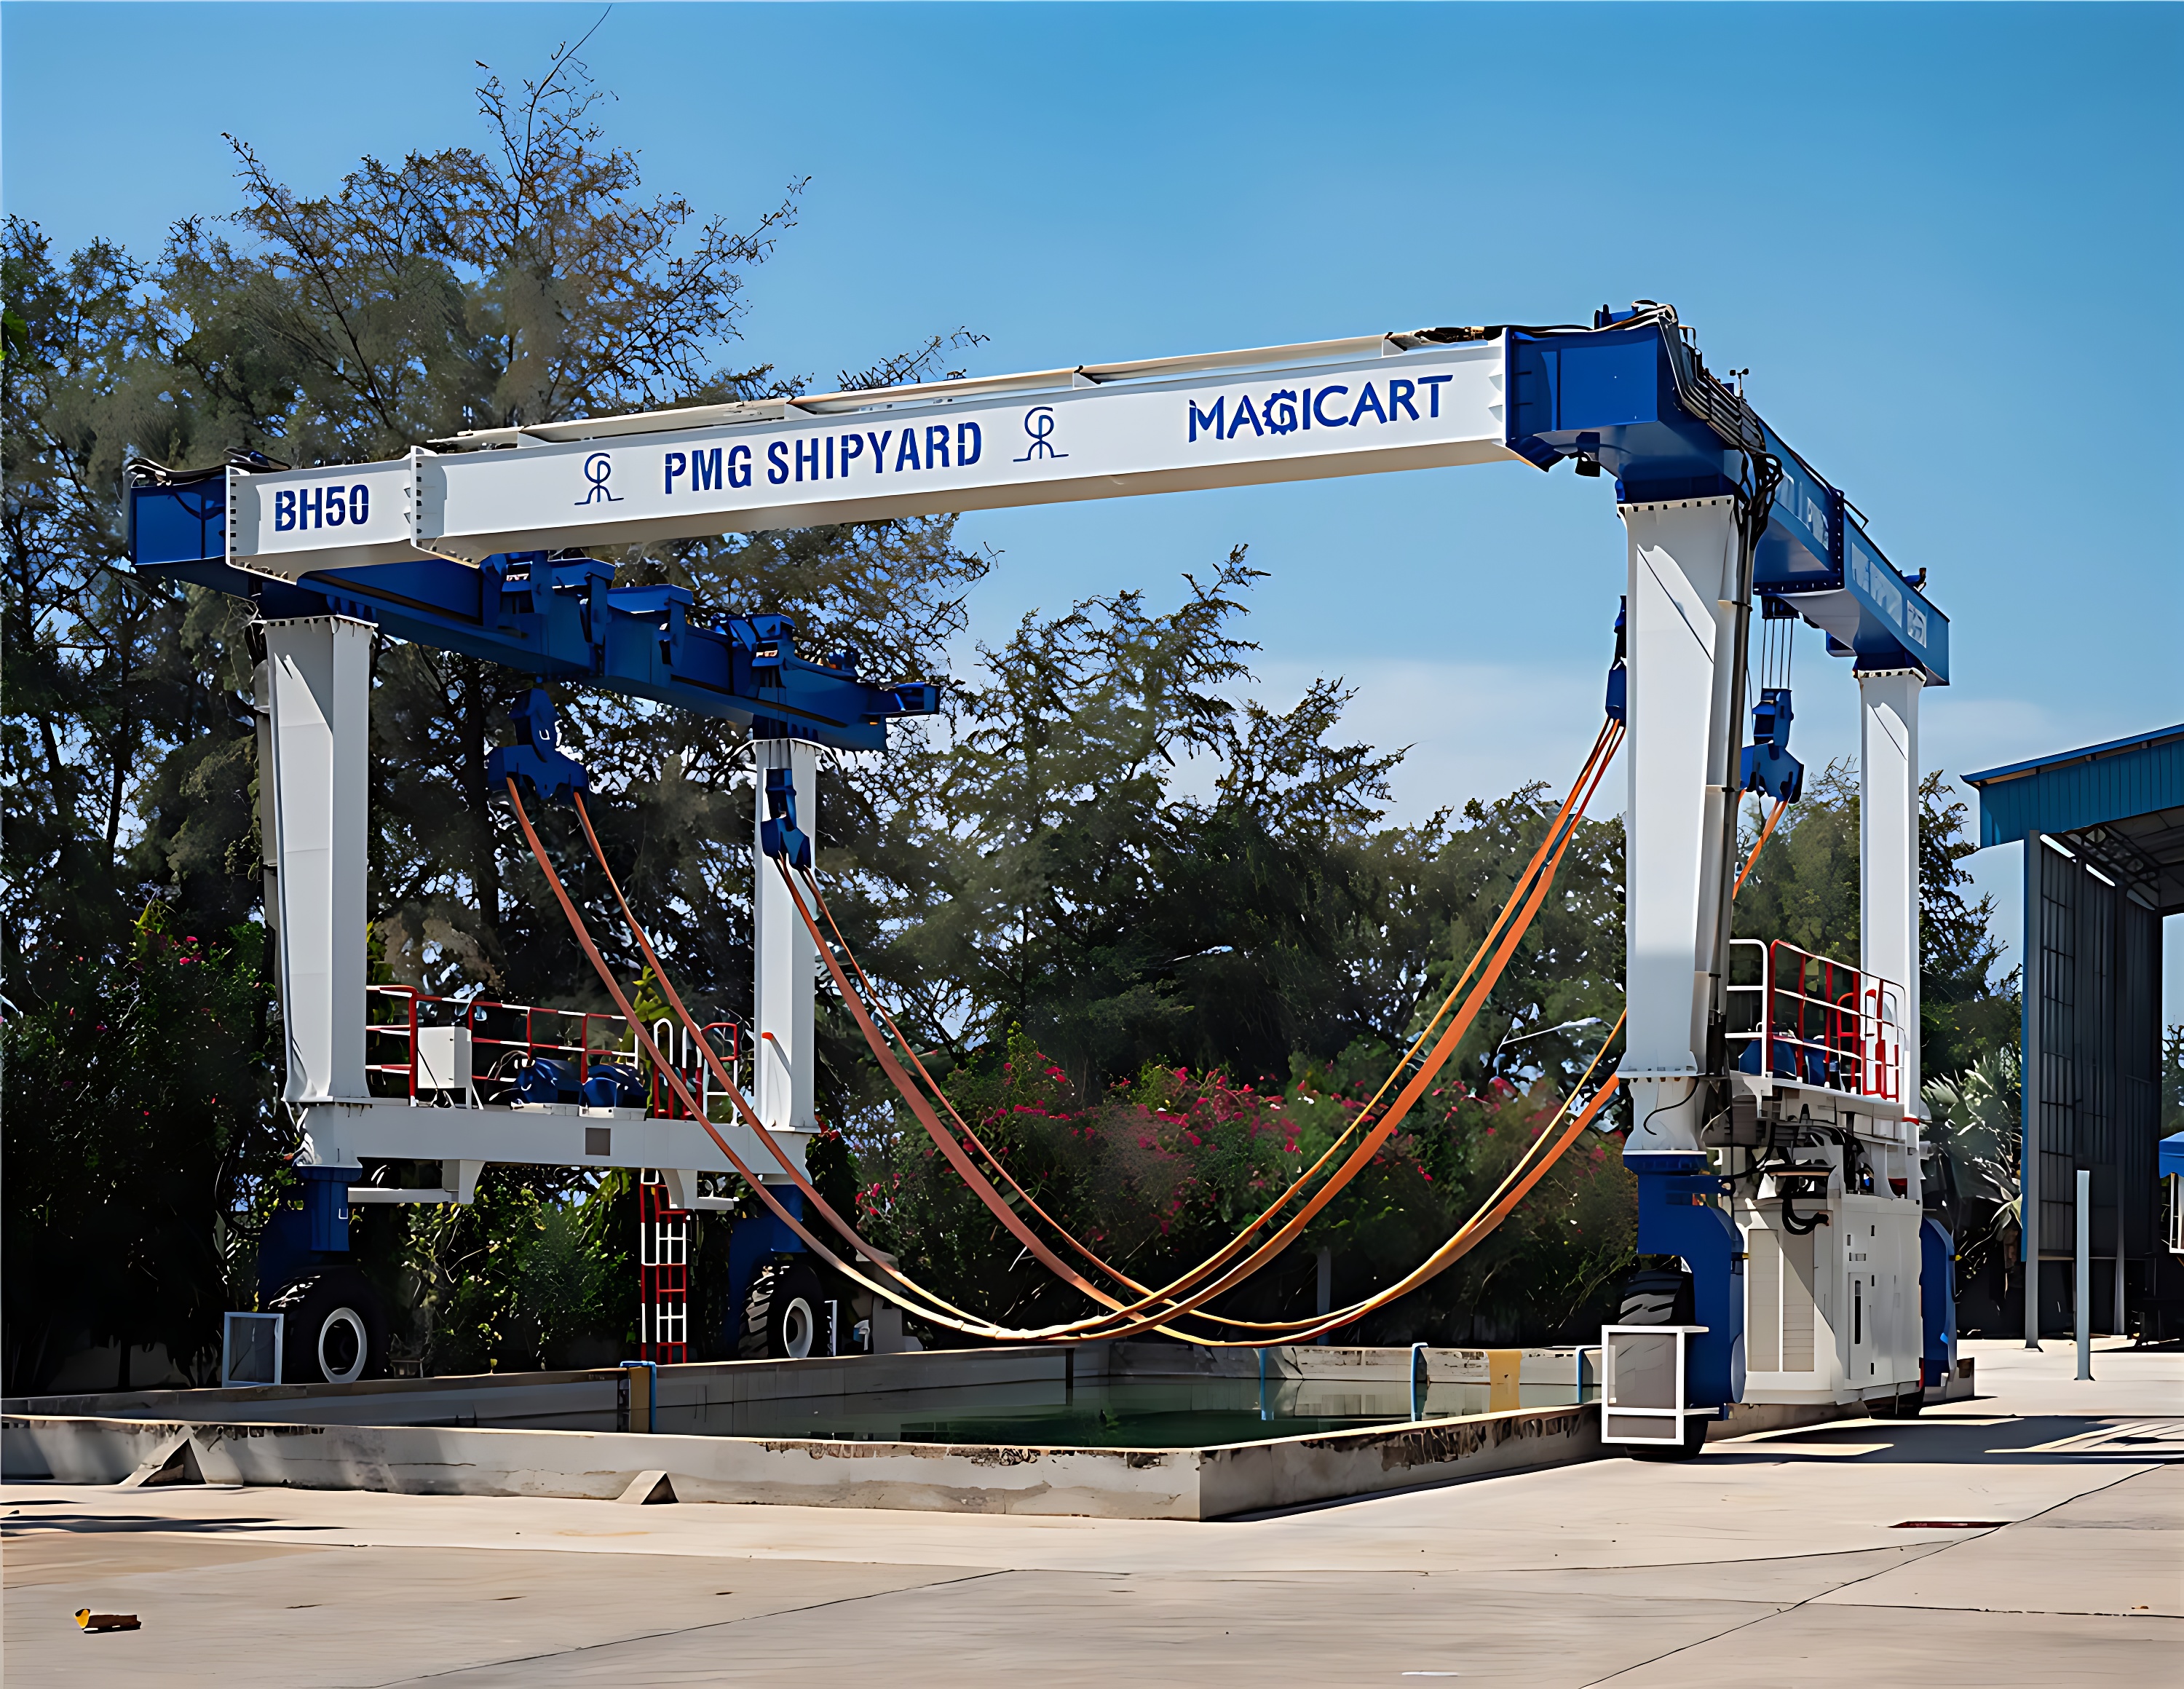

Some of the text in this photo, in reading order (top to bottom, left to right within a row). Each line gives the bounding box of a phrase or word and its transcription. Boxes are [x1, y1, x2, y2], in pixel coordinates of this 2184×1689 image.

[1188, 374, 1454, 443] MAGICART
[665, 422, 983, 495] PMG SHIPYARD
[275, 484, 370, 532] BH50
